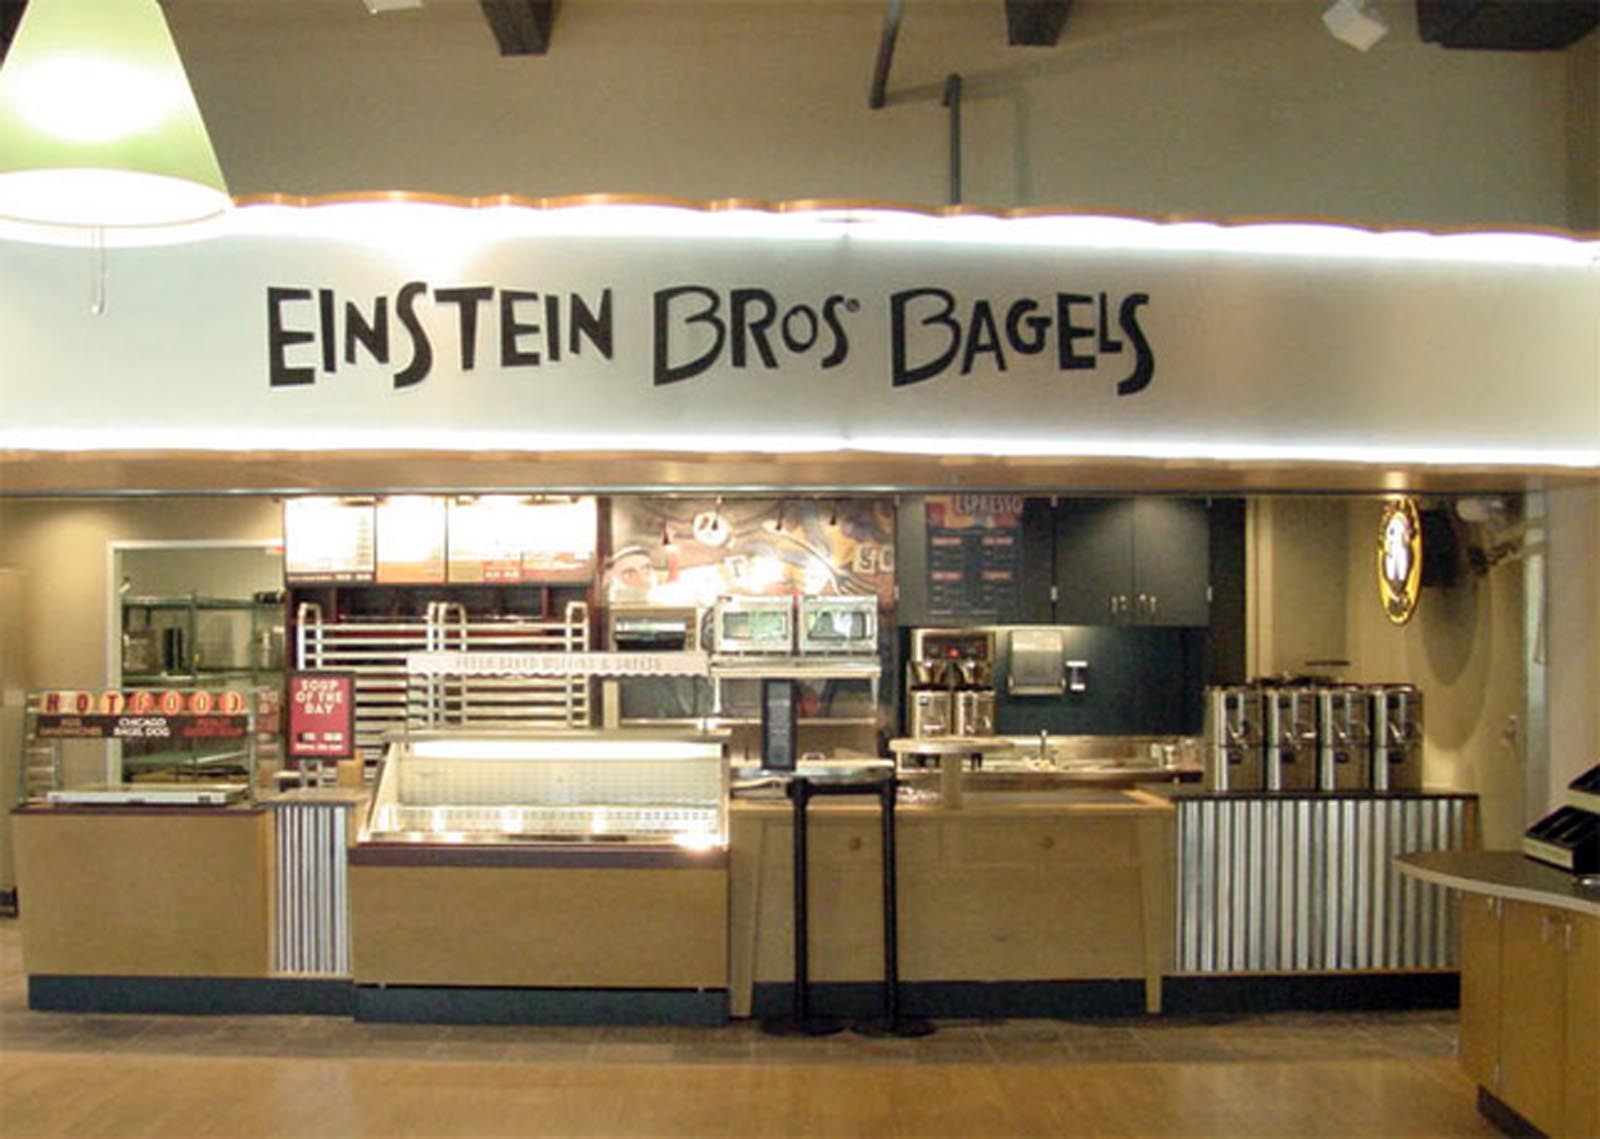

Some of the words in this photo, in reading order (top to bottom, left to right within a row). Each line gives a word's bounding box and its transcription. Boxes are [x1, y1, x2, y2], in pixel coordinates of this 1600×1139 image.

[268, 283, 613, 388] EINSTEIN
[889, 287, 1156, 397] BAGELS
[301, 679, 339, 691] SOUP
[296, 690, 314, 703] OF
[318, 690, 342, 703] THE
[304, 702, 335, 714] DAY
[145, 726, 170, 737] DOG
